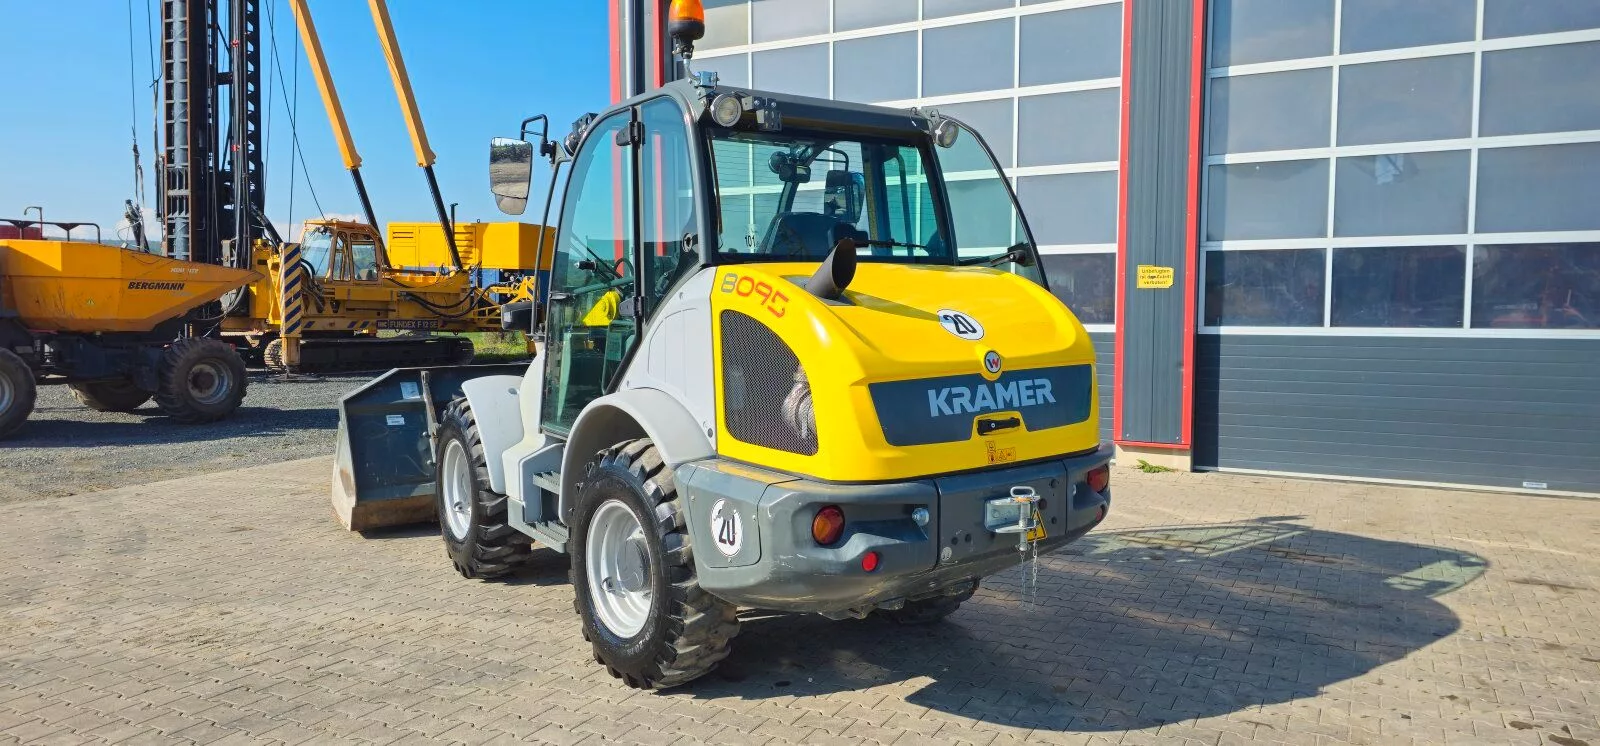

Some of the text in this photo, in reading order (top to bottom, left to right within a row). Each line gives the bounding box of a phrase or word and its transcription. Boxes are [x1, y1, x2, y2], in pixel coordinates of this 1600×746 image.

[745, 235, 755, 247] 101
[128, 281, 185, 290] BERGMANN
[721, 273, 789, 318] 8095
[390, 320, 416, 328] FUNDEX
[943, 314, 977, 334] 20
[927, 378, 1056, 417] KRAMER
